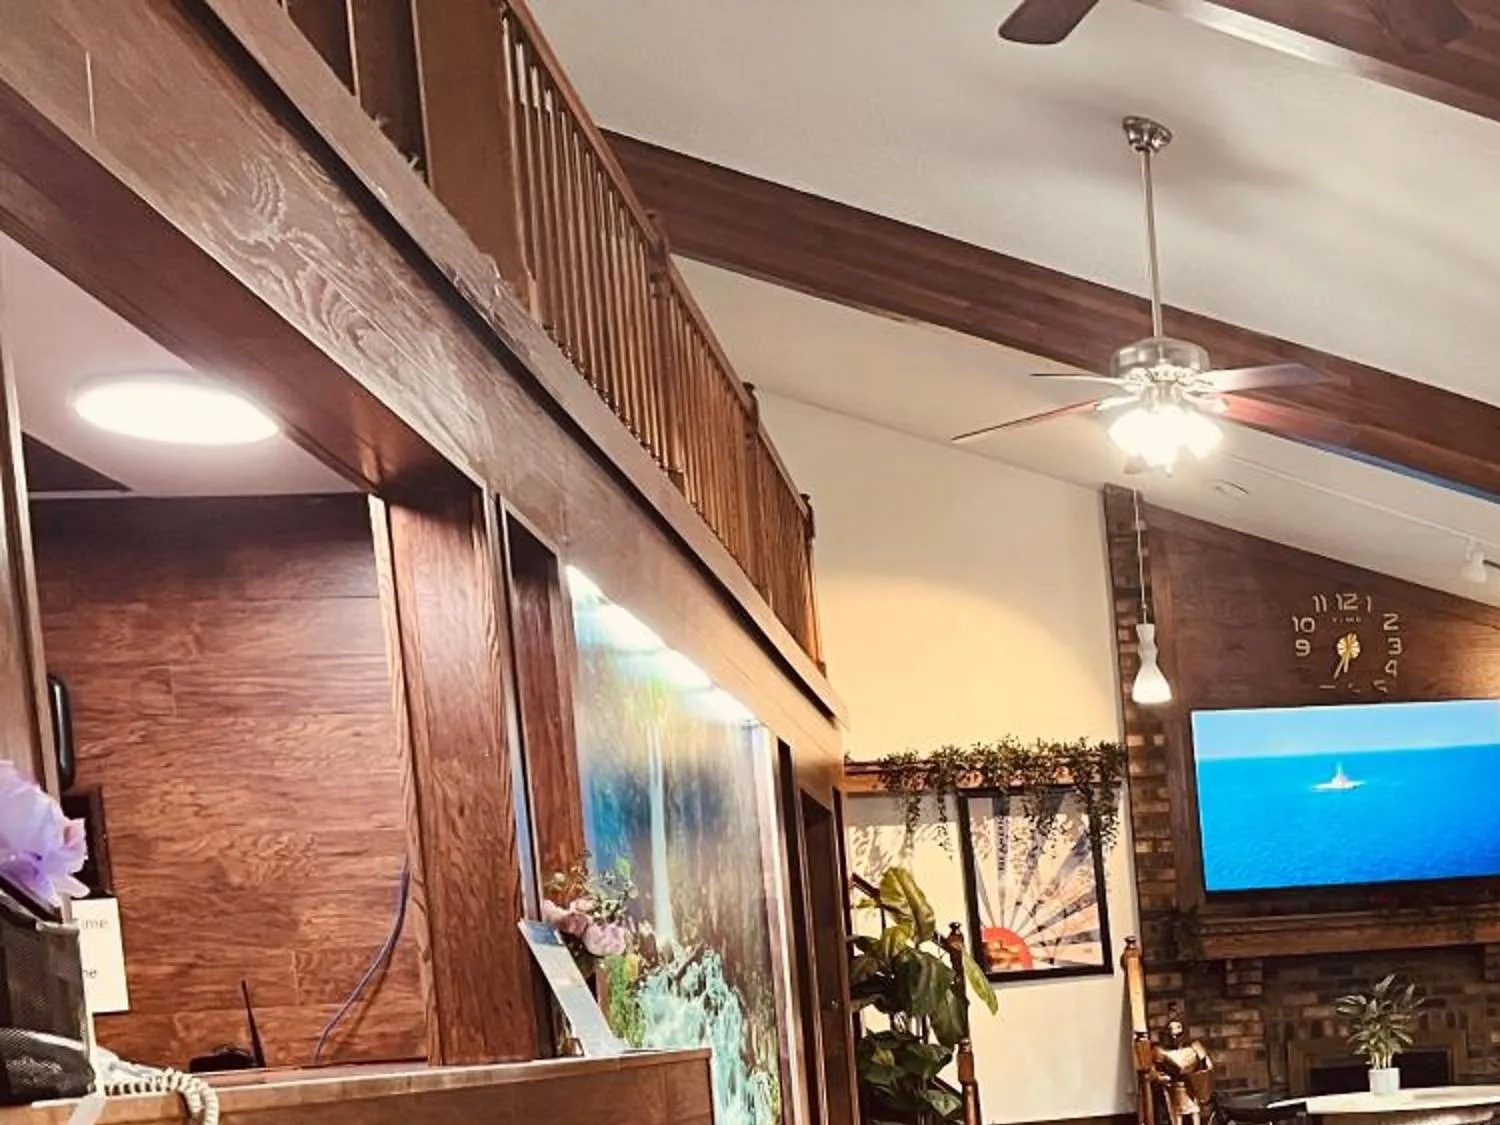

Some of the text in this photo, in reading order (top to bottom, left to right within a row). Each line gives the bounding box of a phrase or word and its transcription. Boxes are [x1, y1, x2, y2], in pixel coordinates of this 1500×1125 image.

[1311, 594, 1328, 613] 11
[1335, 592, 1359, 611] 12
[1366, 595, 1372, 613] 1
[1292, 615, 1316, 633] 10
[1383, 613, 1399, 631] 2
[1295, 639, 1311, 657] 9
[1387, 637, 1402, 656] 3
[1384, 659, 1398, 679] 4
